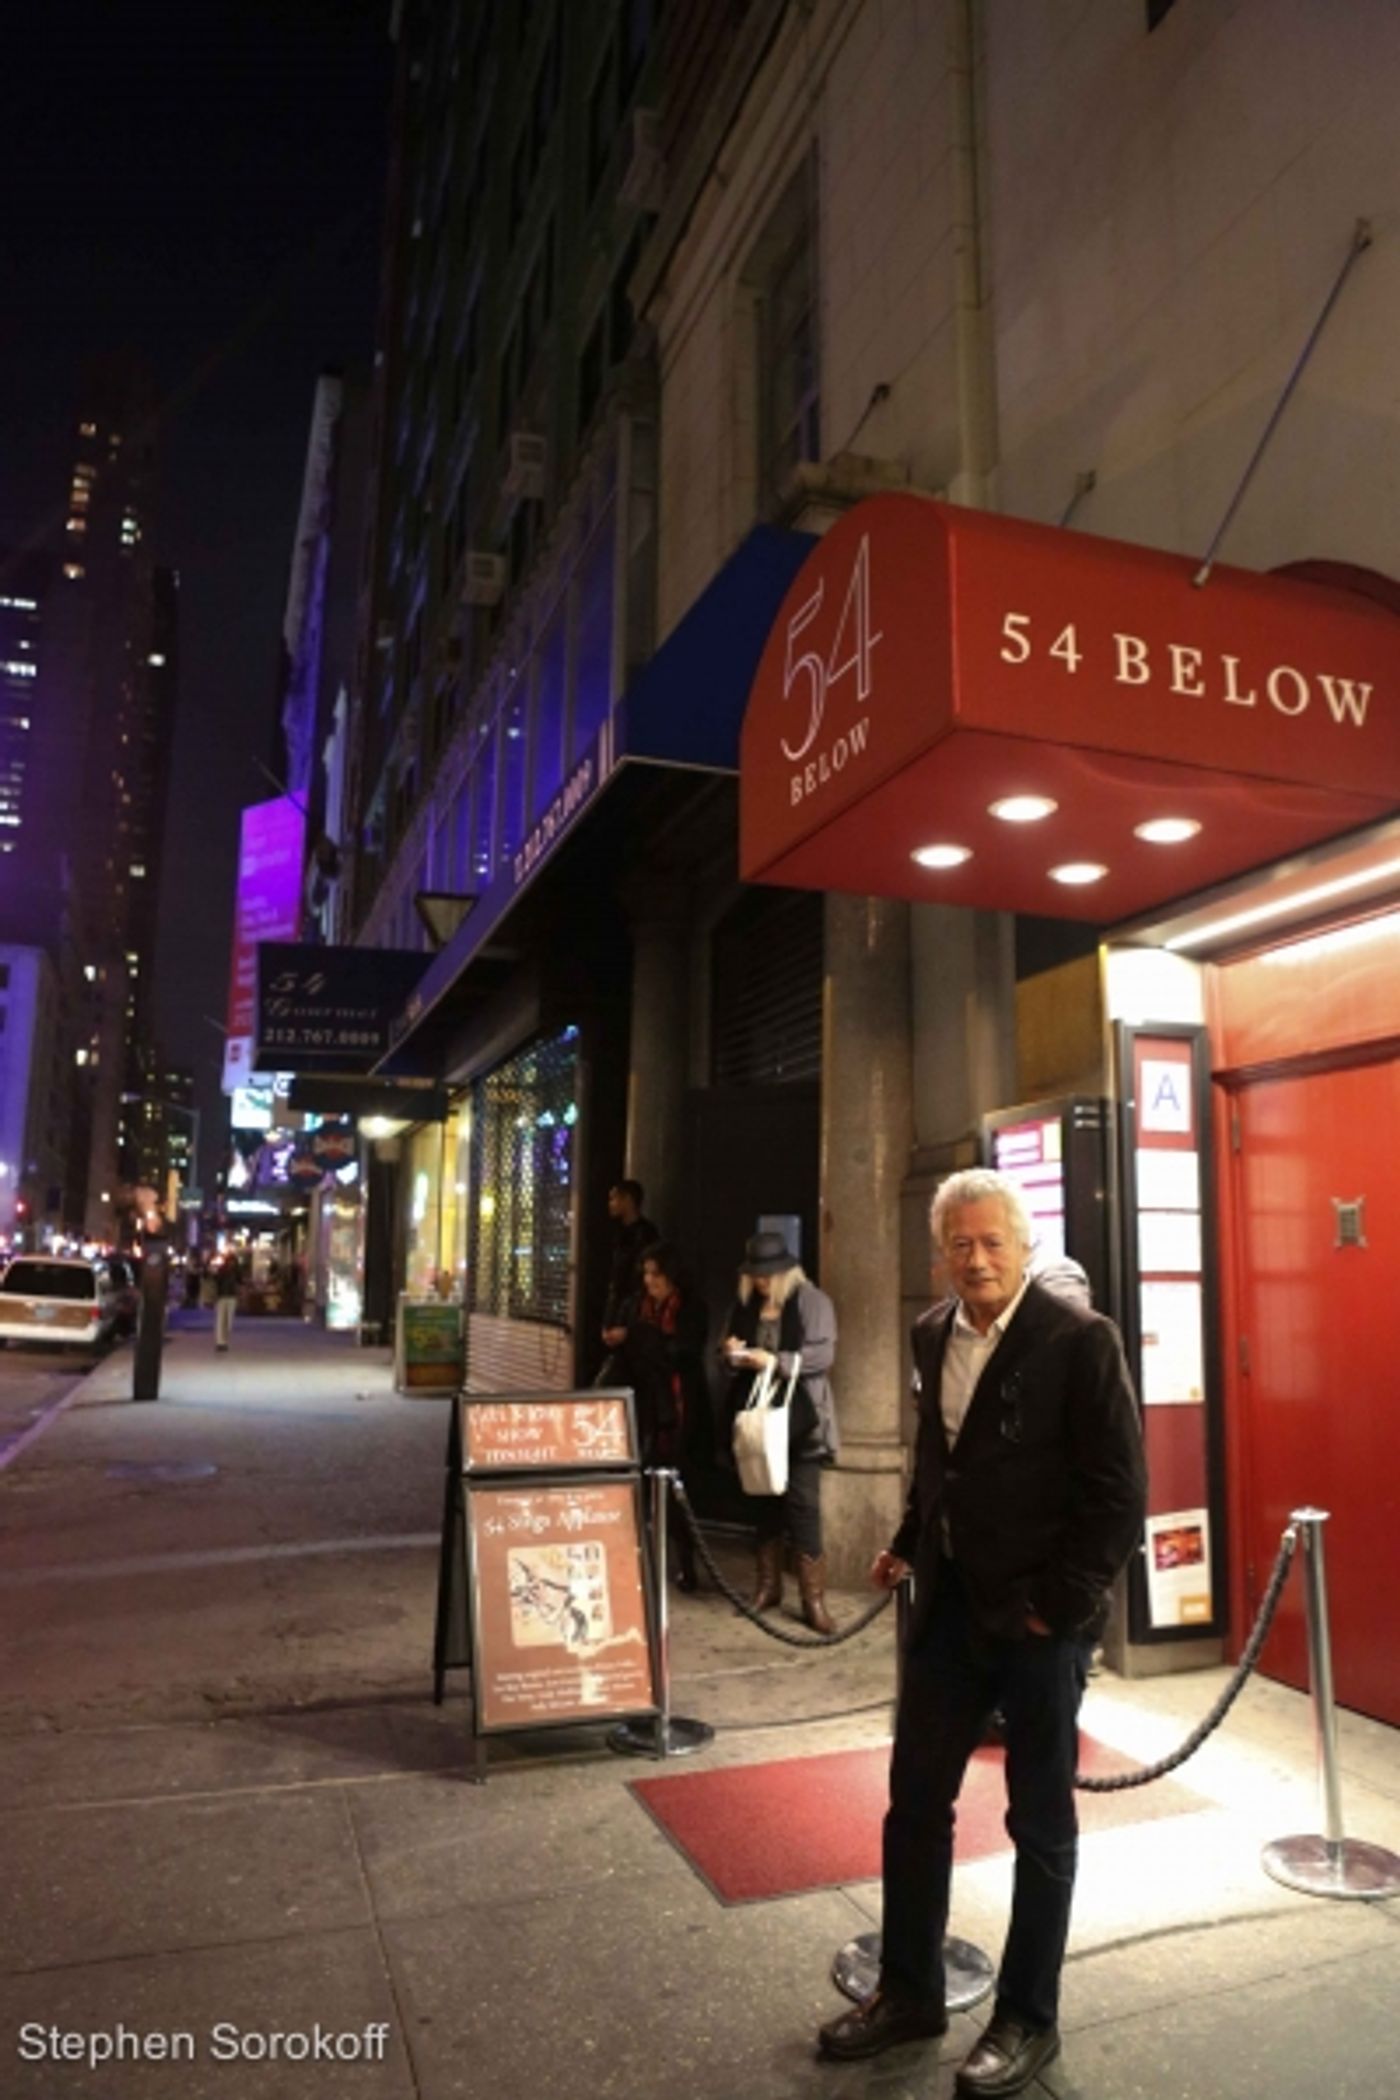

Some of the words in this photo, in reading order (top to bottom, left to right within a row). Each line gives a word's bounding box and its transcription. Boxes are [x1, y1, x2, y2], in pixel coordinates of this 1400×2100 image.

[780, 532, 883, 760] 54
[1000, 612, 1083, 673] 54
[1112, 632, 1373, 726] BELOW
[790, 717, 870, 806] BELOW
[1151, 1071, 1181, 1111] A
[571, 1402, 625, 1448] 54
